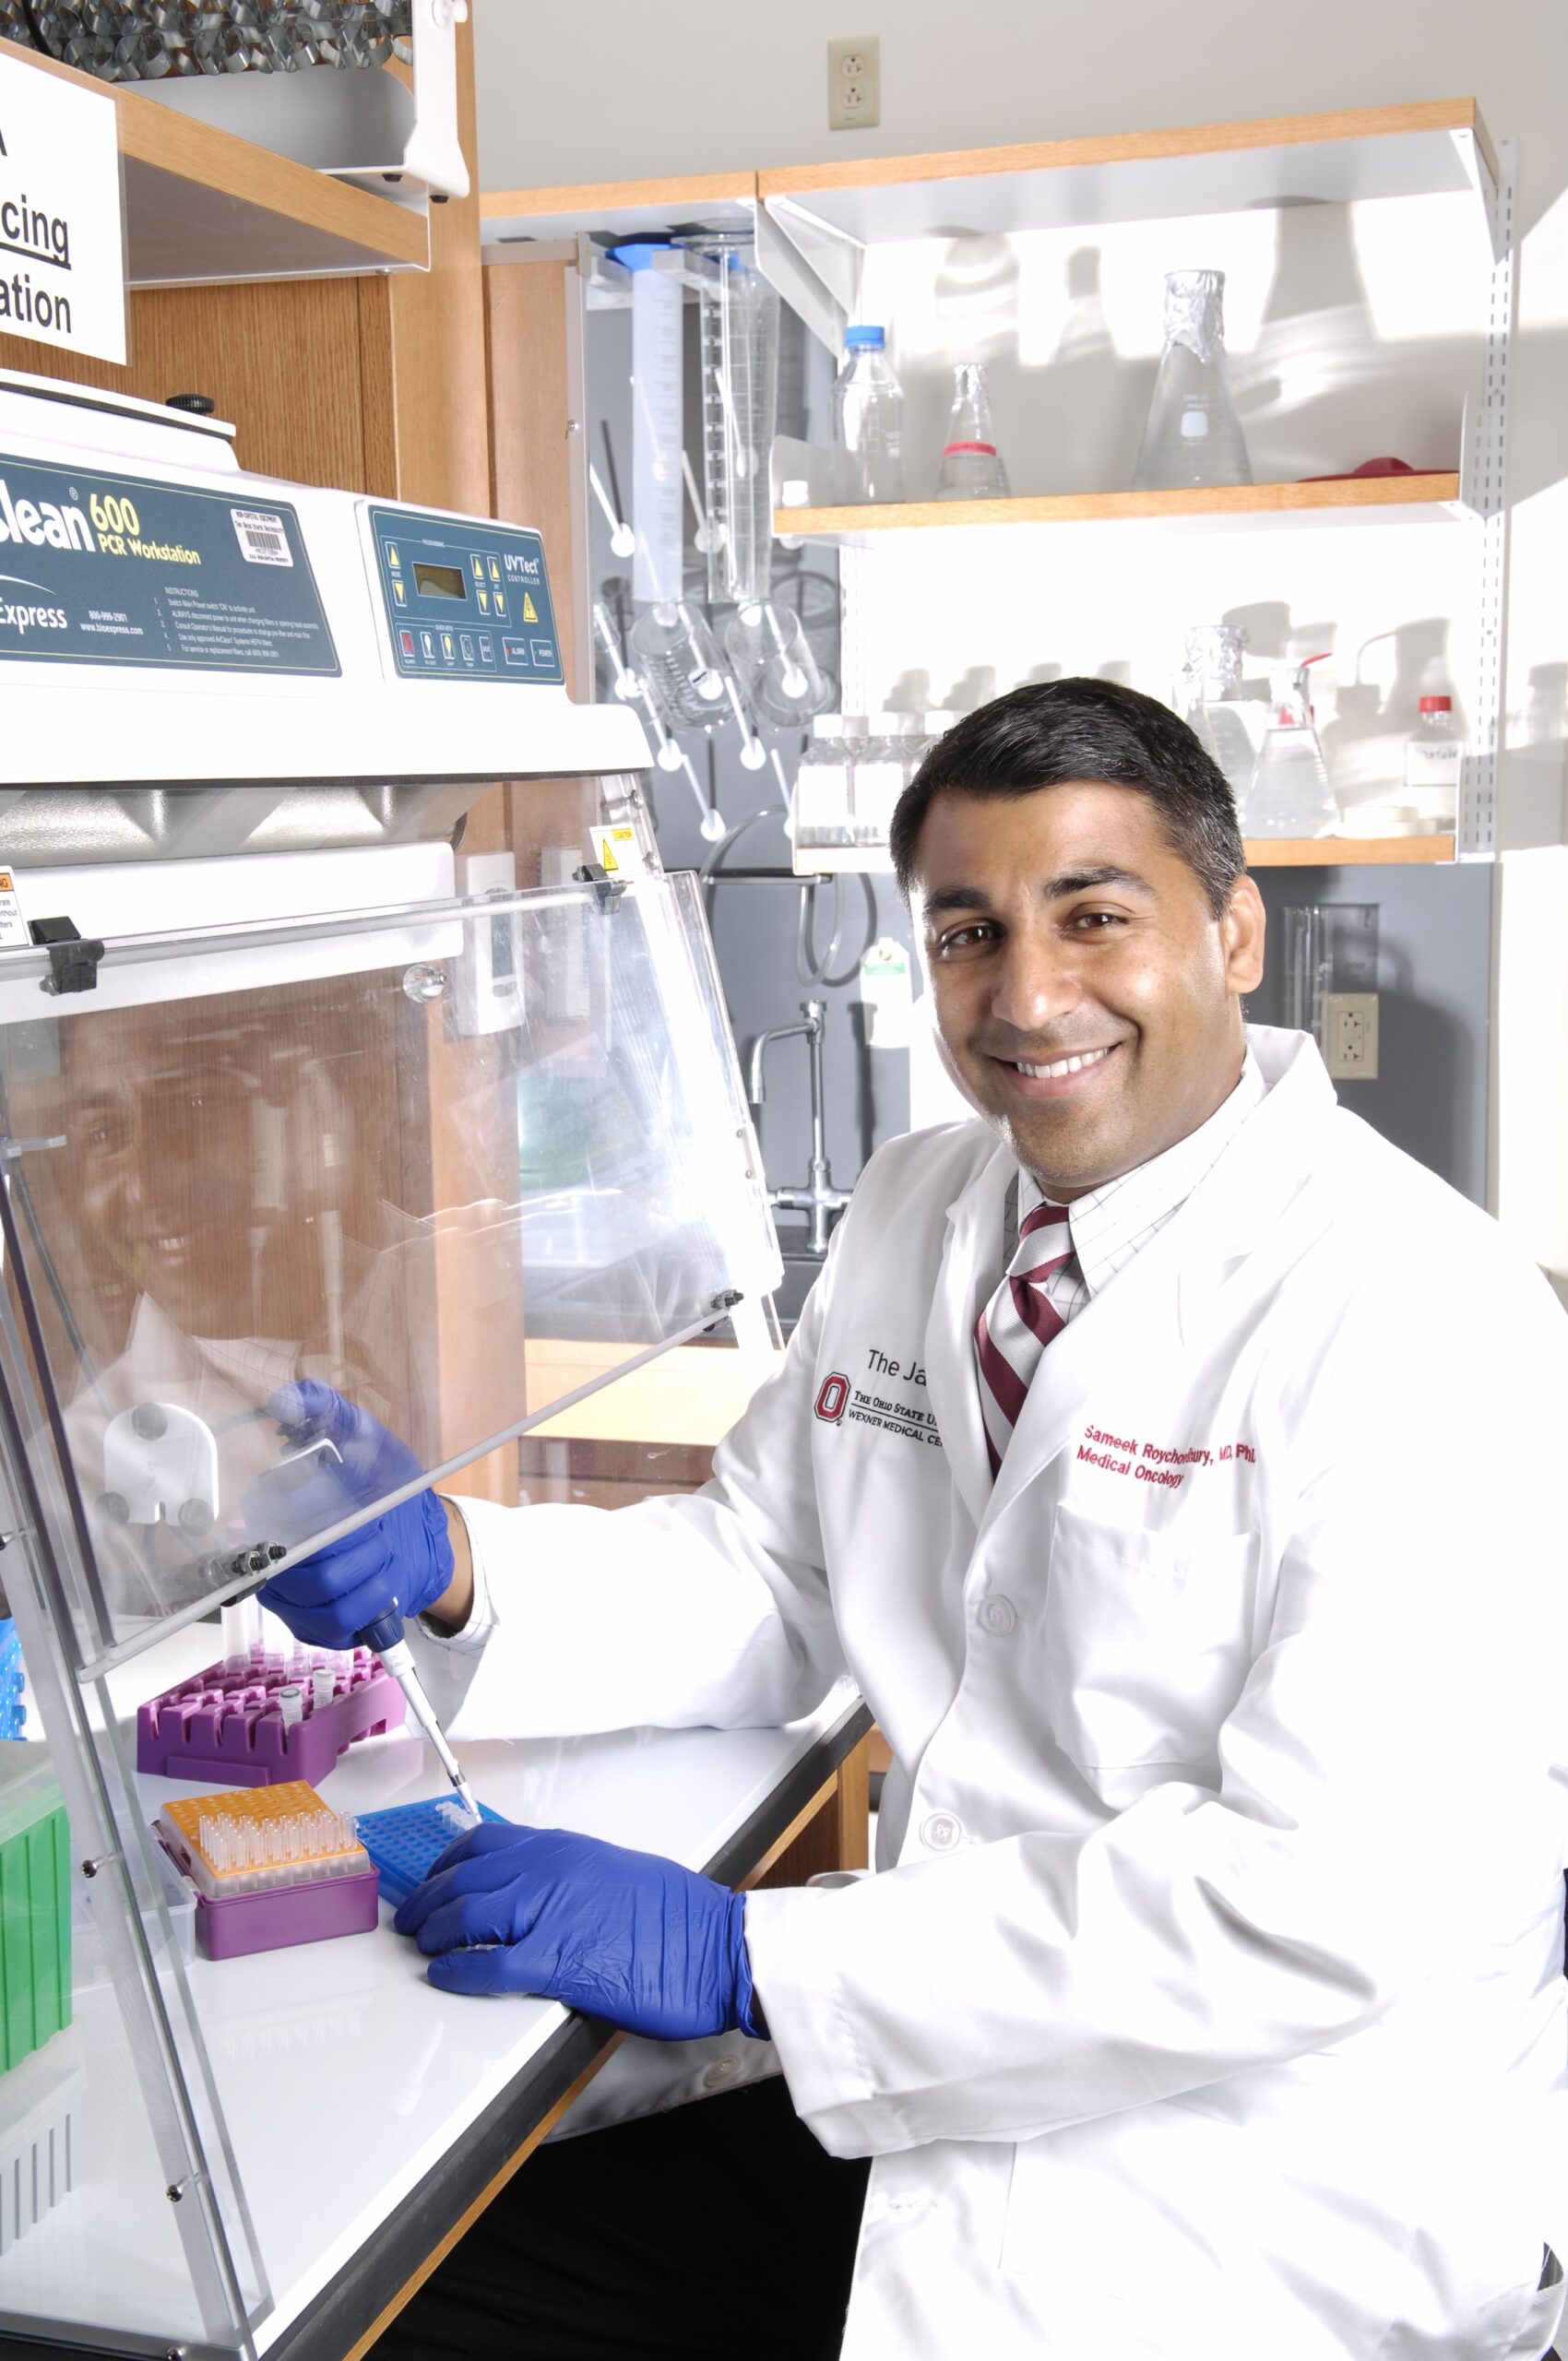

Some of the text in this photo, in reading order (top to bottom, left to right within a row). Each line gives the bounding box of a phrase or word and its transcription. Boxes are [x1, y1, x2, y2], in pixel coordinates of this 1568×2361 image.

[2, 194, 71, 270] cing
[89, 493, 140, 535] 600
[97, 533, 201, 564] PCR Workstation
[507, 574, 540, 585] CONTROLLER
[79, 623, 144, 635] www.bioexpress.com
[868, 1348, 927, 1386] The Ja
[849, 1409, 943, 1447] WEXNER MEDICAL CE
[894, 1404, 925, 1421] STATE
[926, 1415, 937, 1426] U
[1084, 1425, 1139, 1455] Sameek
[1076, 1444, 1184, 1489] Medical Oncology
